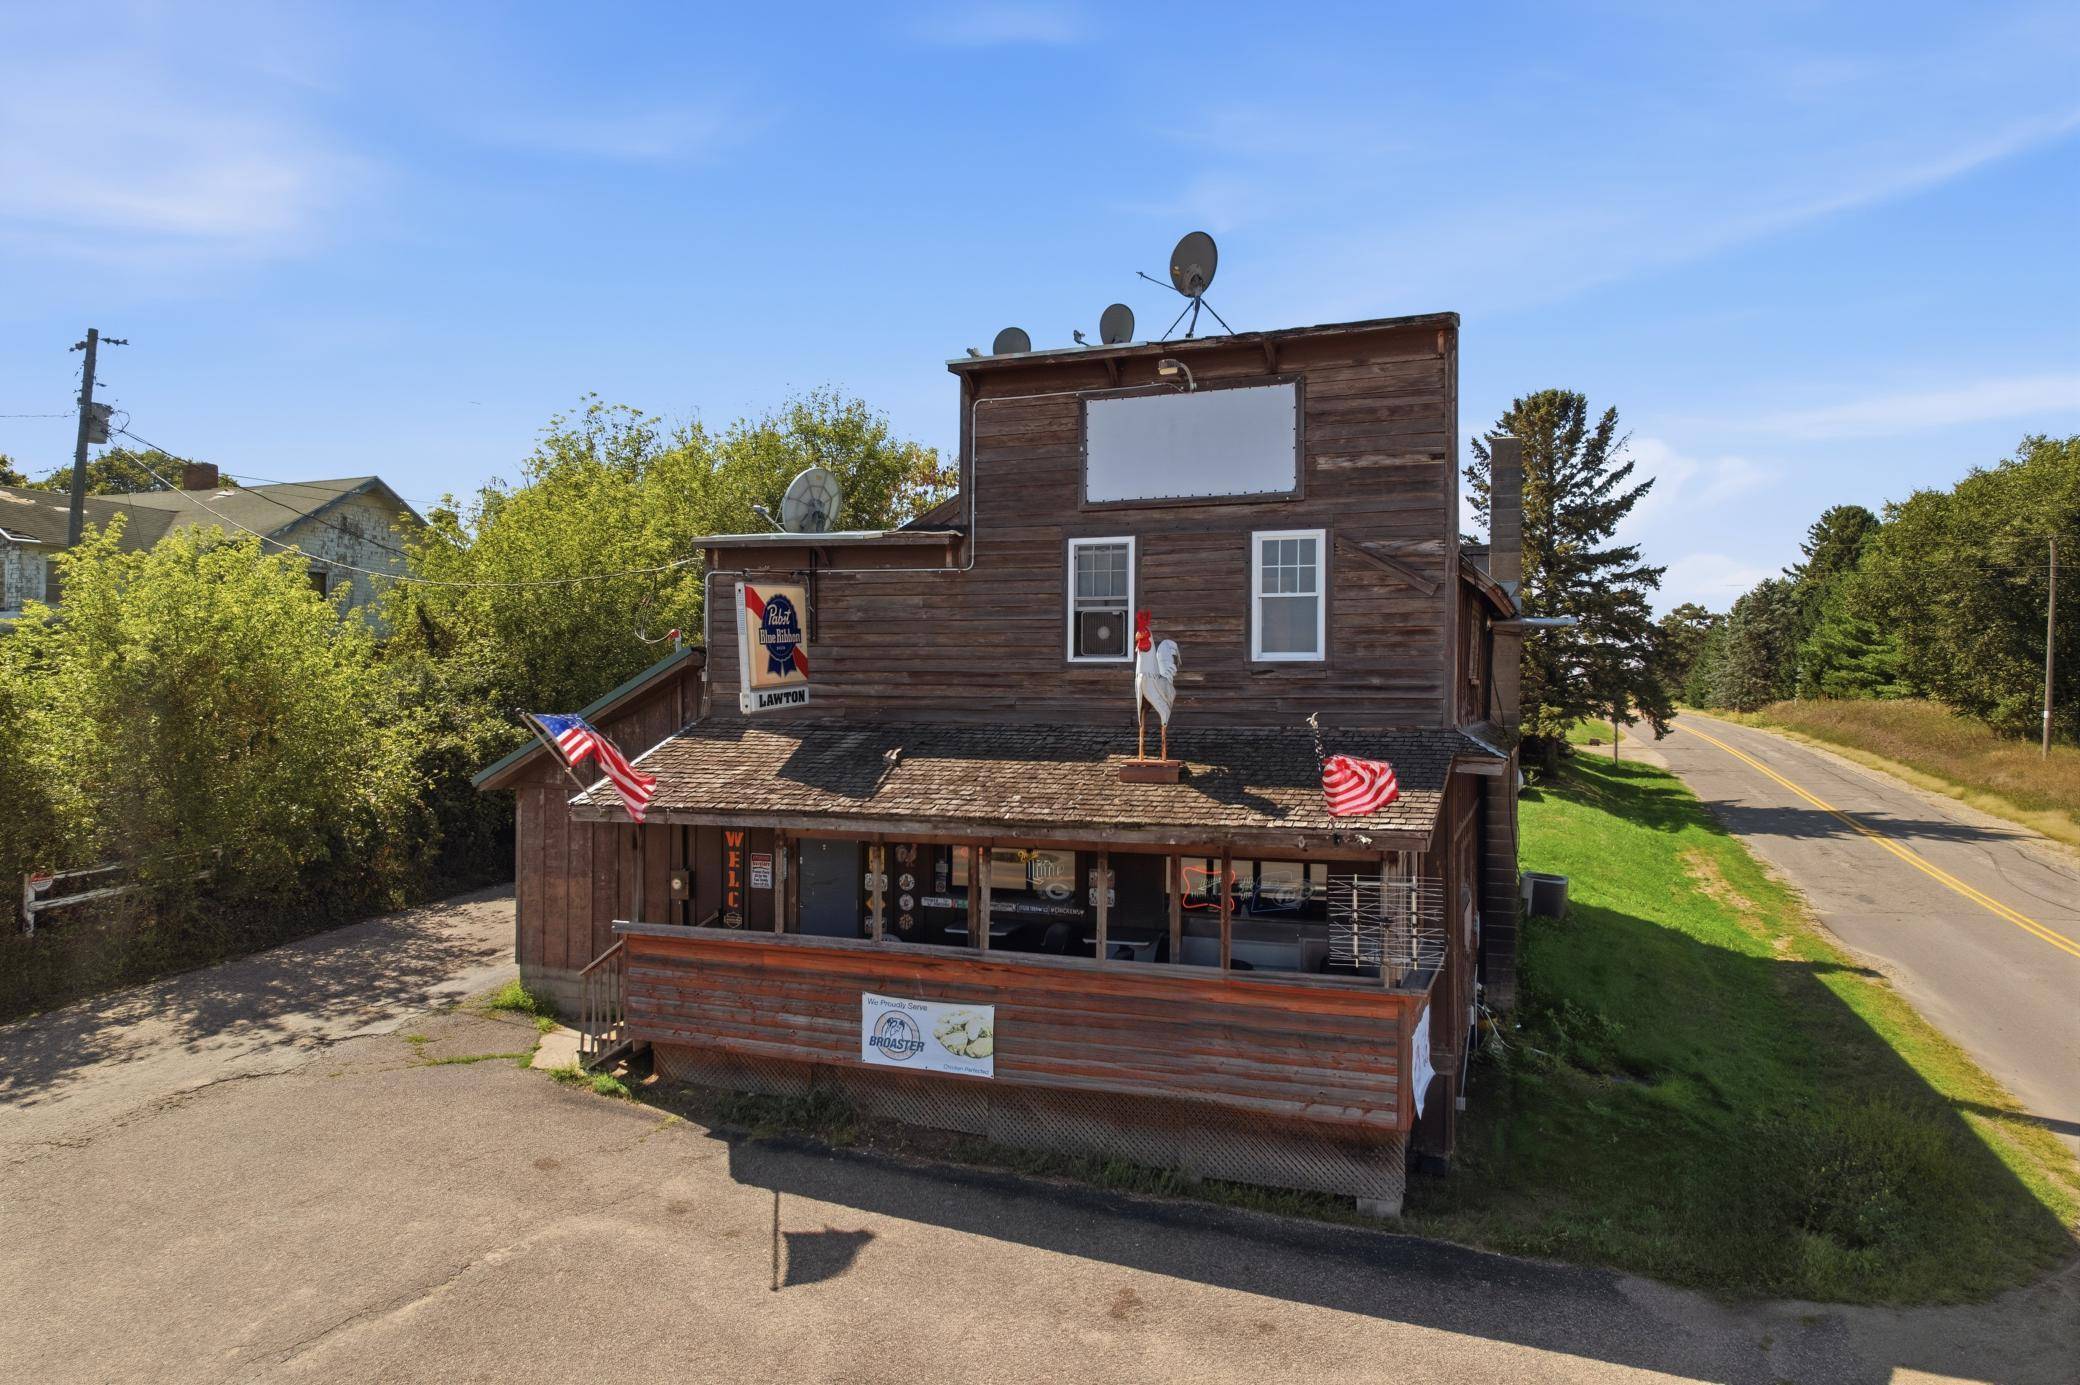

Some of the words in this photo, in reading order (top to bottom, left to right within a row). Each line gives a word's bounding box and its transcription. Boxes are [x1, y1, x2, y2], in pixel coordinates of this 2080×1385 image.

[767, 604, 791, 625] Pabst
[760, 629, 776, 644] Blue
[777, 628, 800, 644] Ribbon
[759, 690, 805, 707] LAWTON
[867, 998, 879, 1006] We
[880, 999, 906, 1010] Proudly
[907, 1002, 928, 1011] Serve
[869, 1035, 925, 1053] BROASTER
